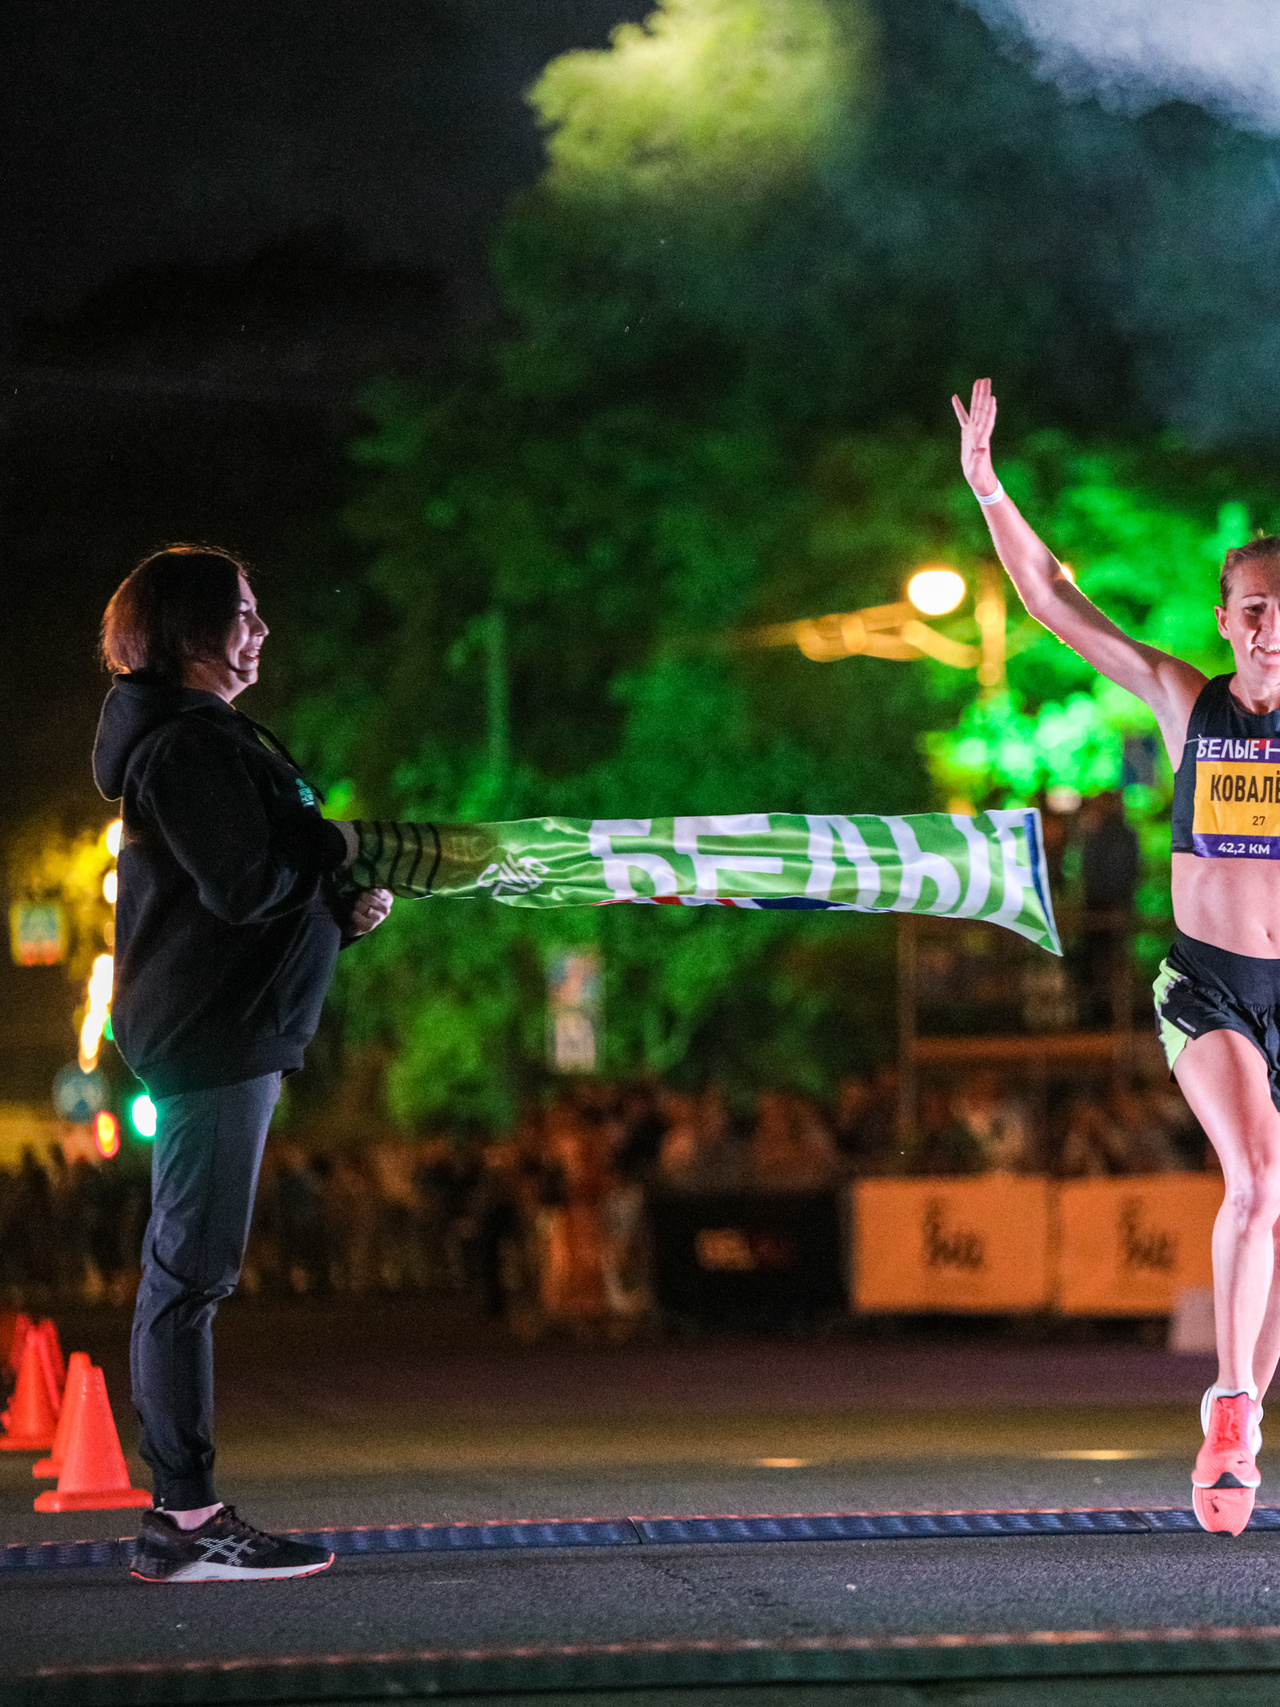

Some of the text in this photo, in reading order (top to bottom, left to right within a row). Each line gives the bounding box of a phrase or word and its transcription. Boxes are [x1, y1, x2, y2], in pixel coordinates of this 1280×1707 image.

[1196, 738, 1260, 760] БЕЛЫЕ
[1252, 815, 1266, 826] 27
[1217, 842, 1271, 855] 42,2 КМ
[588, 808, 1048, 942] БЕЛЫЕ
